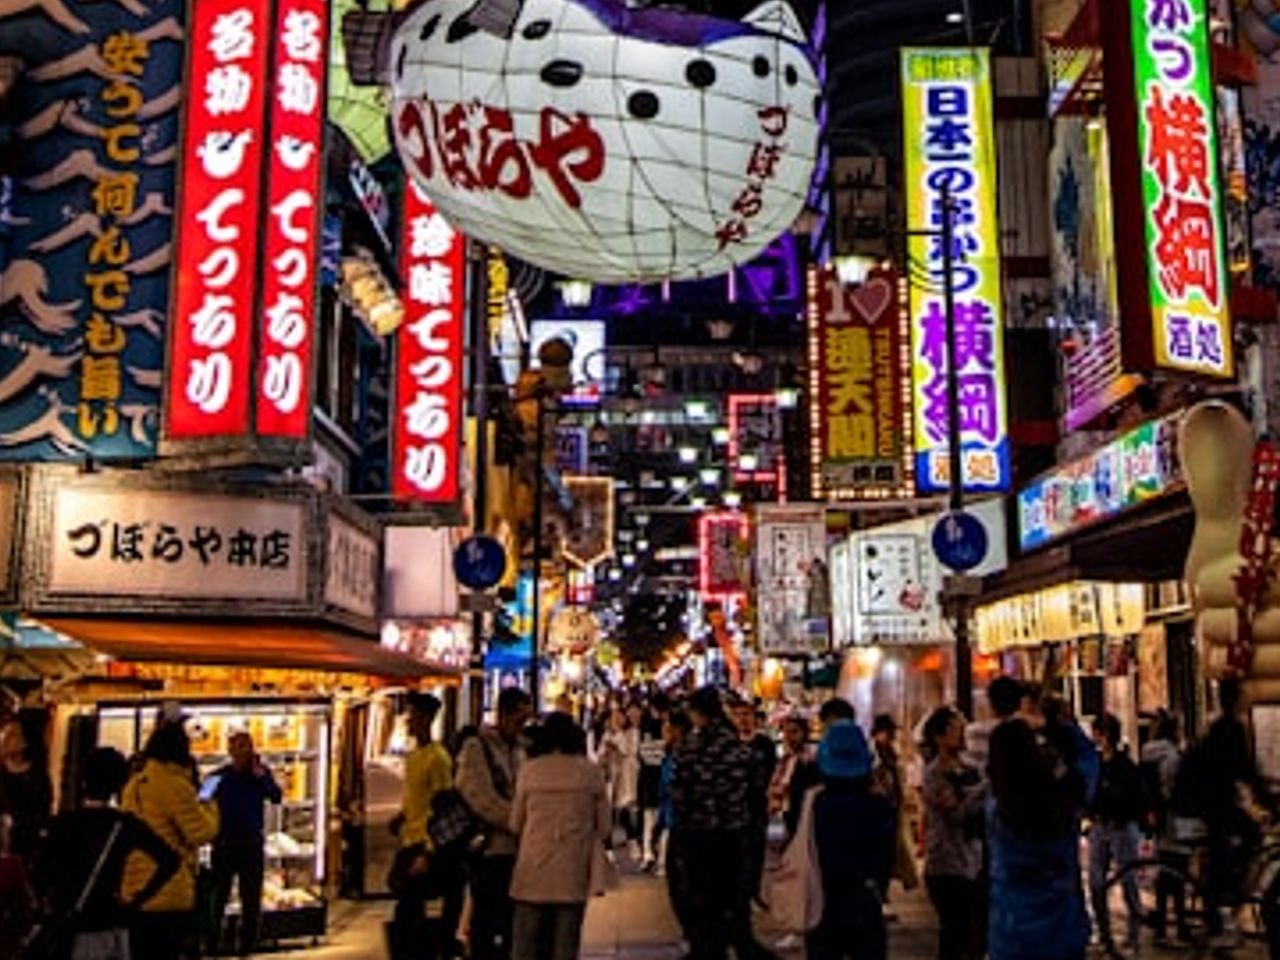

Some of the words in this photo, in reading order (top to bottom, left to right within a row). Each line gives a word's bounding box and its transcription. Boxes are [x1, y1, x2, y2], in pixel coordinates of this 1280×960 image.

[208, 8, 255, 115] 名物
[277, 8, 321, 116] 名物
[923, 86, 981, 292] 日本一の串かつ
[1147, 86, 1220, 308] 横綱
[1165, 316, 1222, 366] 酒処
[67, 521, 293, 569] づぼらや本店
